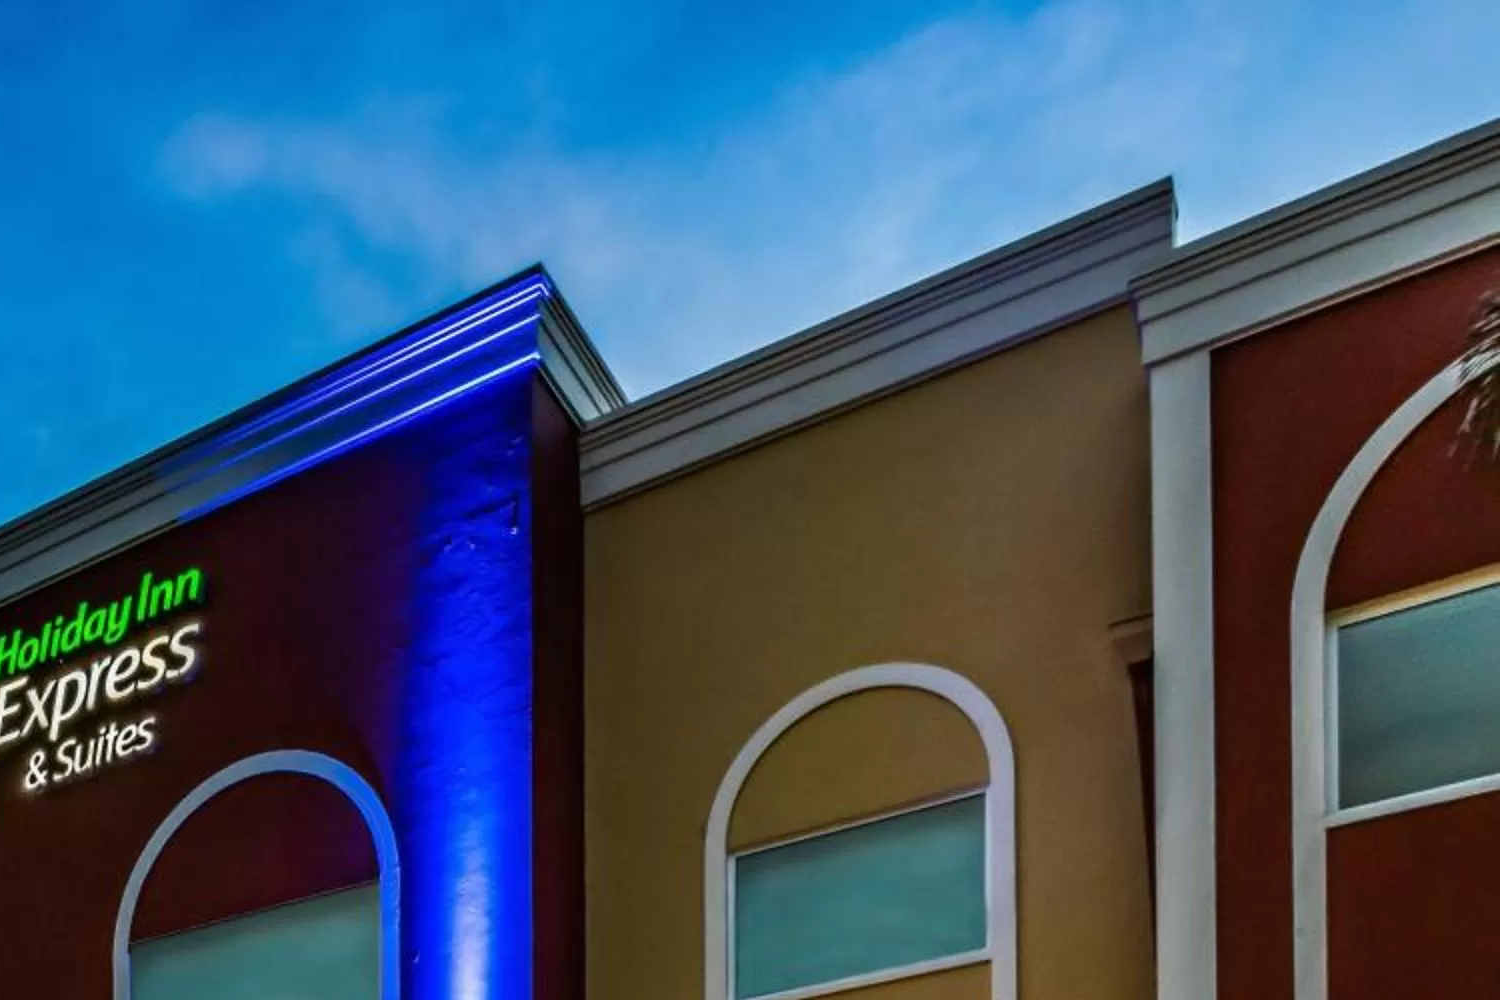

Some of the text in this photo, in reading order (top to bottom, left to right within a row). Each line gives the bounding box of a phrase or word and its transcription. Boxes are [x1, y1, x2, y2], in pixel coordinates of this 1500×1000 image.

[137, 570, 201, 622] Inn
[23, 717, 156, 790] & Suites
